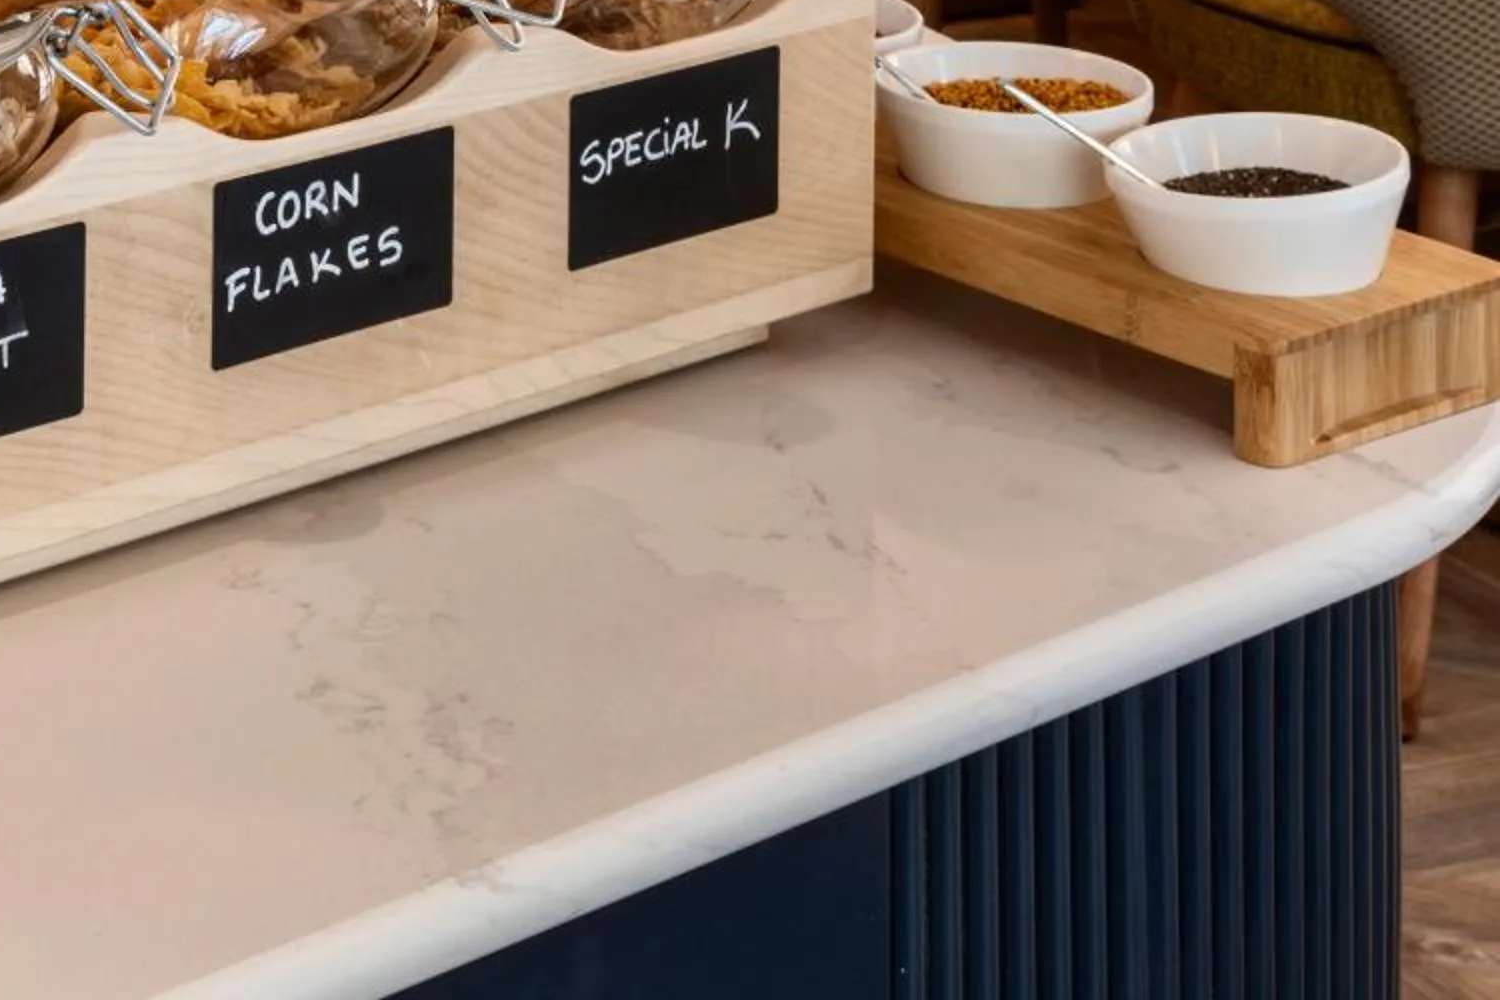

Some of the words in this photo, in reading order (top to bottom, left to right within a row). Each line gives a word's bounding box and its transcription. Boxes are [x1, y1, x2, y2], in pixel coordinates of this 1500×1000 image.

[723, 98, 762, 151] K
[255, 171, 361, 236] CORN
[224, 225, 404, 313] FLAKES
